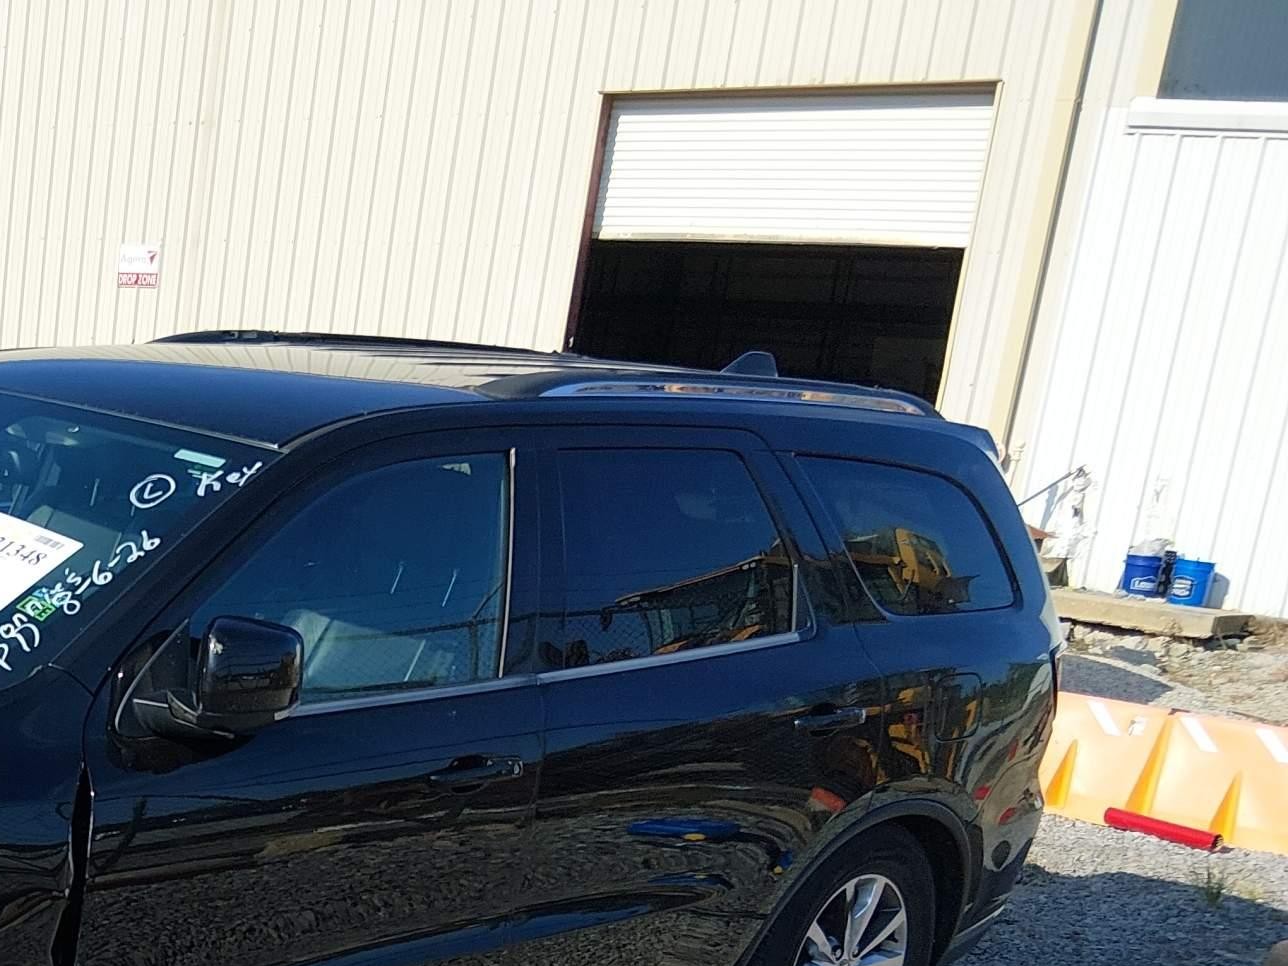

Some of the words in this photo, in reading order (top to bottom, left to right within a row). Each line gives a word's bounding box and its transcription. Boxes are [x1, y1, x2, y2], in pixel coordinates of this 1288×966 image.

[119, 274, 137, 285] DROP
[137, 274, 156, 286] ZONE
[54, 529, 161, 615] 8-6-26
